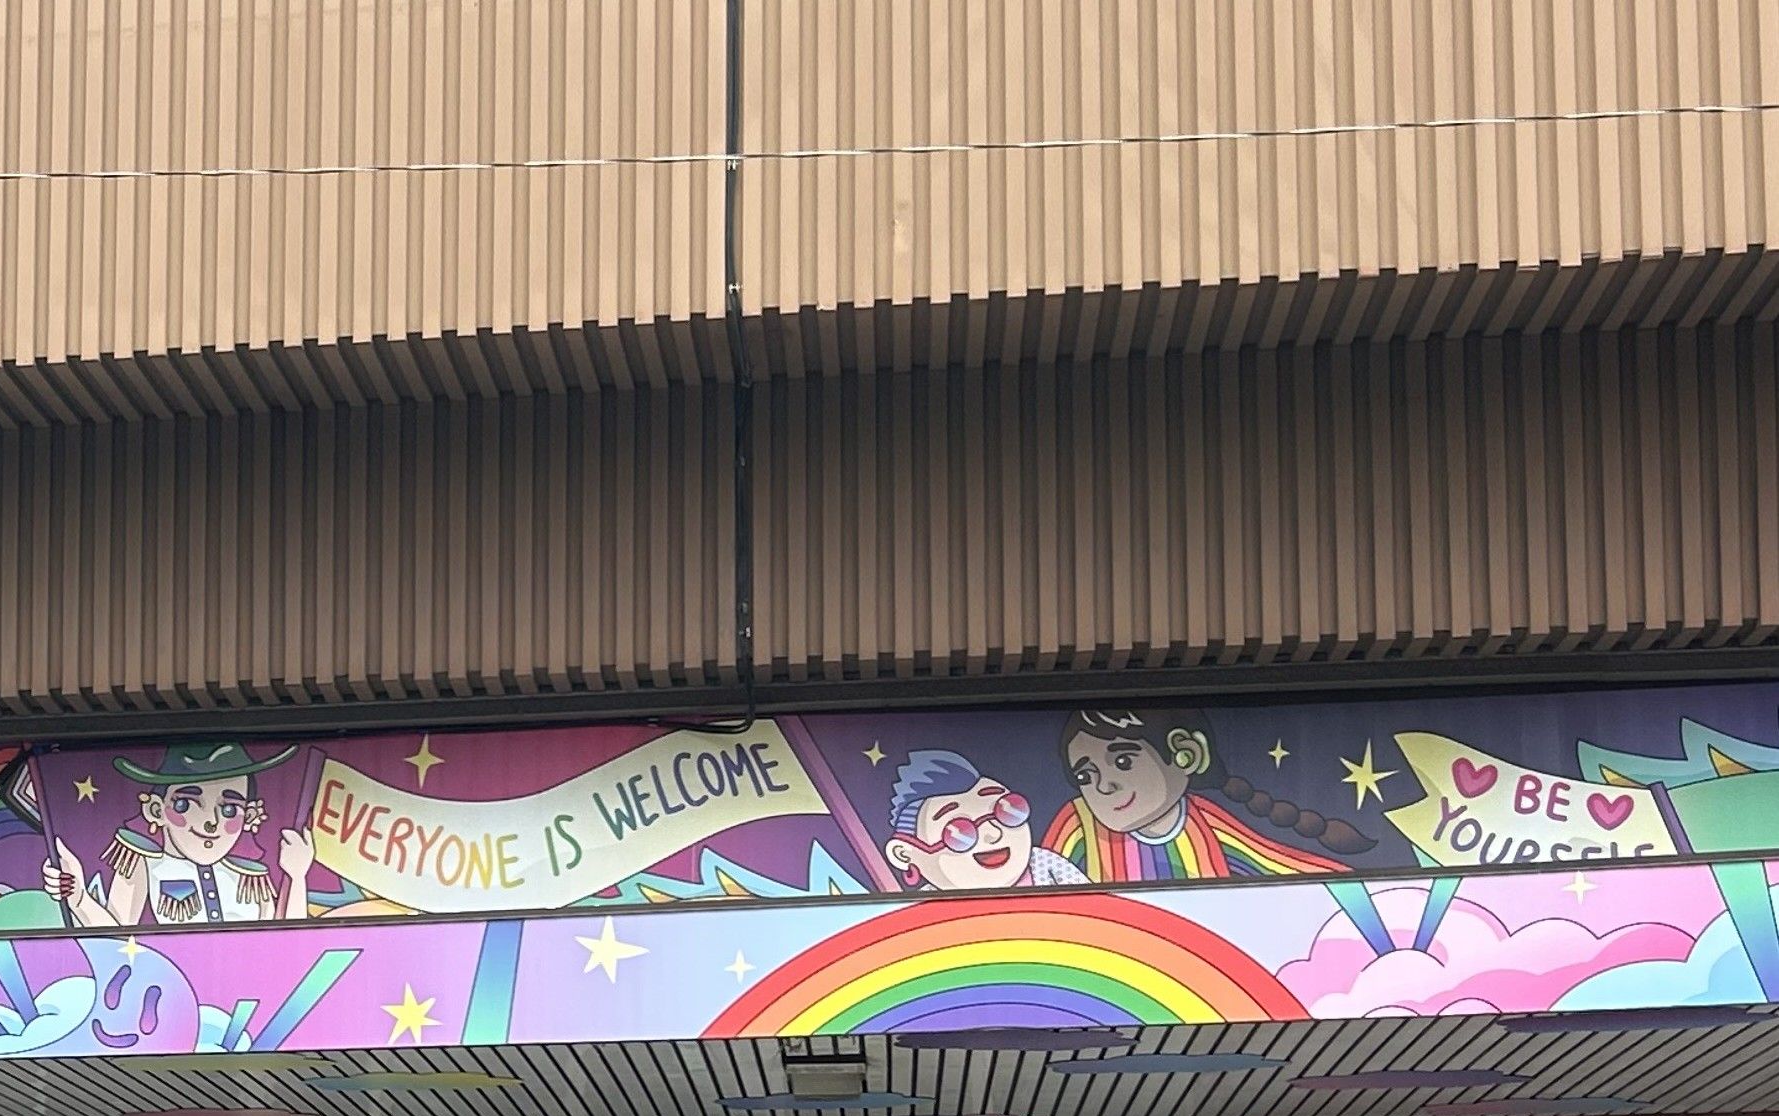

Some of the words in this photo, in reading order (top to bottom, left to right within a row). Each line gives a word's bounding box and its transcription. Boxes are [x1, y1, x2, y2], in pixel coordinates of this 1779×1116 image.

[316, 779, 525, 890] EVERYONE
[545, 814, 582, 878] IS
[592, 742, 790, 841] WELCOME
[1513, 773, 1571, 822] BE
